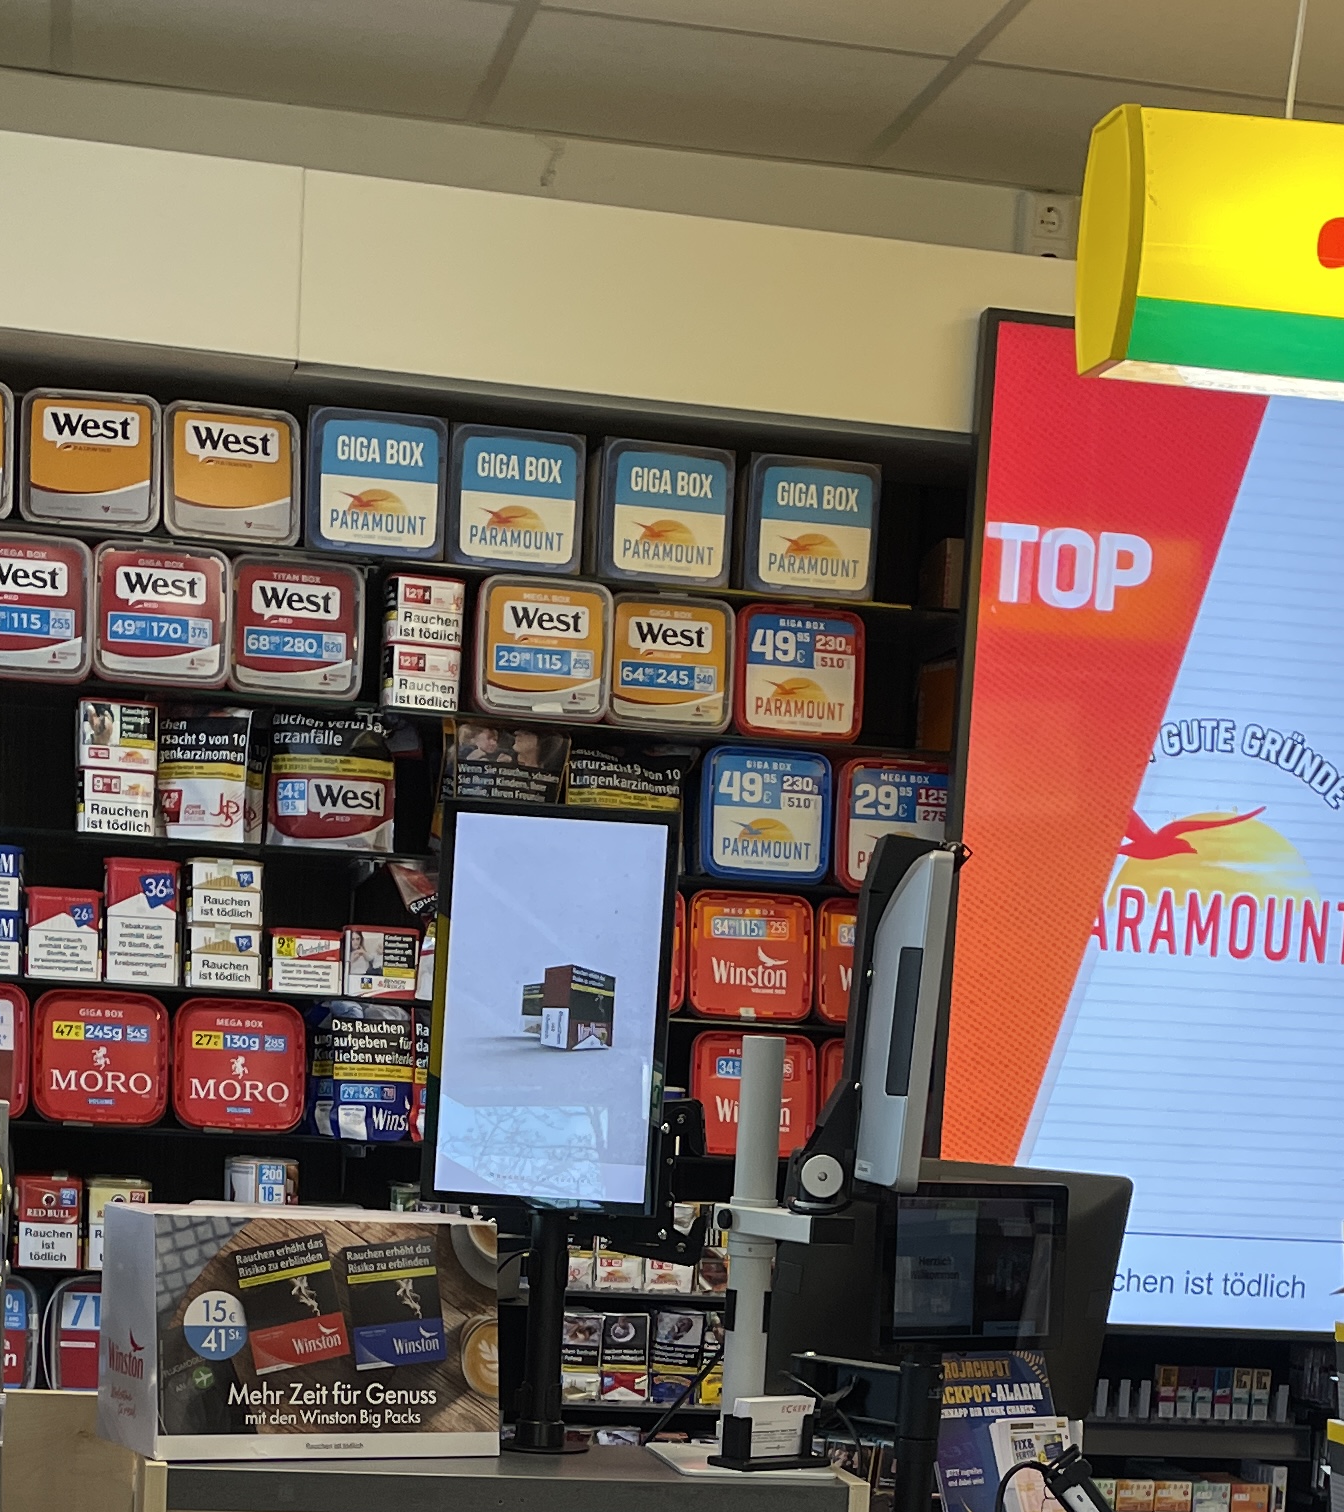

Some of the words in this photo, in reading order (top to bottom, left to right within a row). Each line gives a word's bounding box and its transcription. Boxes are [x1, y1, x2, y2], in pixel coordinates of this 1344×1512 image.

[51, 411, 132, 441] West
[193, 425, 272, 456] West
[477, 451, 520, 479] GIGA
[524, 456, 562, 484] BOX
[330, 508, 426, 537] PARAMOUNT
[469, 524, 563, 553] PARAMOUNT
[622, 538, 714, 566] PARAMOUNT
[768, 552, 858, 580] PARAMOUNT
[986, 522, 1154, 611] TOP
[123, 572, 198, 598] West
[273, 730, 343, 746] erzanfälle
[1160, 717, 1235, 757] GUTE
[314, 784, 382, 811] West
[90, 804, 149, 818] Rauchen
[722, 837, 812, 861] PARAMOUNT
[203, 895, 251, 907] Rauchen
[711, 956, 787, 988] Winston
[332, 1019, 353, 1031] Das
[356, 1020, 404, 1035] Rauchen
[50, 1069, 153, 1095] MORO
[189, 1078, 289, 1103] MORO
[26, 1207, 46, 1218] RED
[47, 1209, 71, 1218] BULL
[25, 1227, 73, 1239] Rauchen
[29, 1251, 67, 1262] tödlich
[348, 1262, 374, 1273] Risiko
[375, 1261, 386, 1270] zu
[387, 1255, 430, 1269] erblinden
[1185, 1270, 1214, 1296] ist
[1223, 1272, 1305, 1299] tödlich
[291, 1332, 342, 1356] Winston
[392, 1336, 440, 1356] Winston
[228, 1382, 286, 1405] Mehr
[290, 1382, 329, 1405] Zeit
[332, 1382, 362, 1408] für
[366, 1384, 437, 1405] Genuss
[245, 1411, 267, 1426] mit
[270, 1411, 296, 1426] den
[300, 1410, 357, 1426] Winston
[360, 1410, 382, 1429] Big
[384, 1410, 421, 1426] Packs
